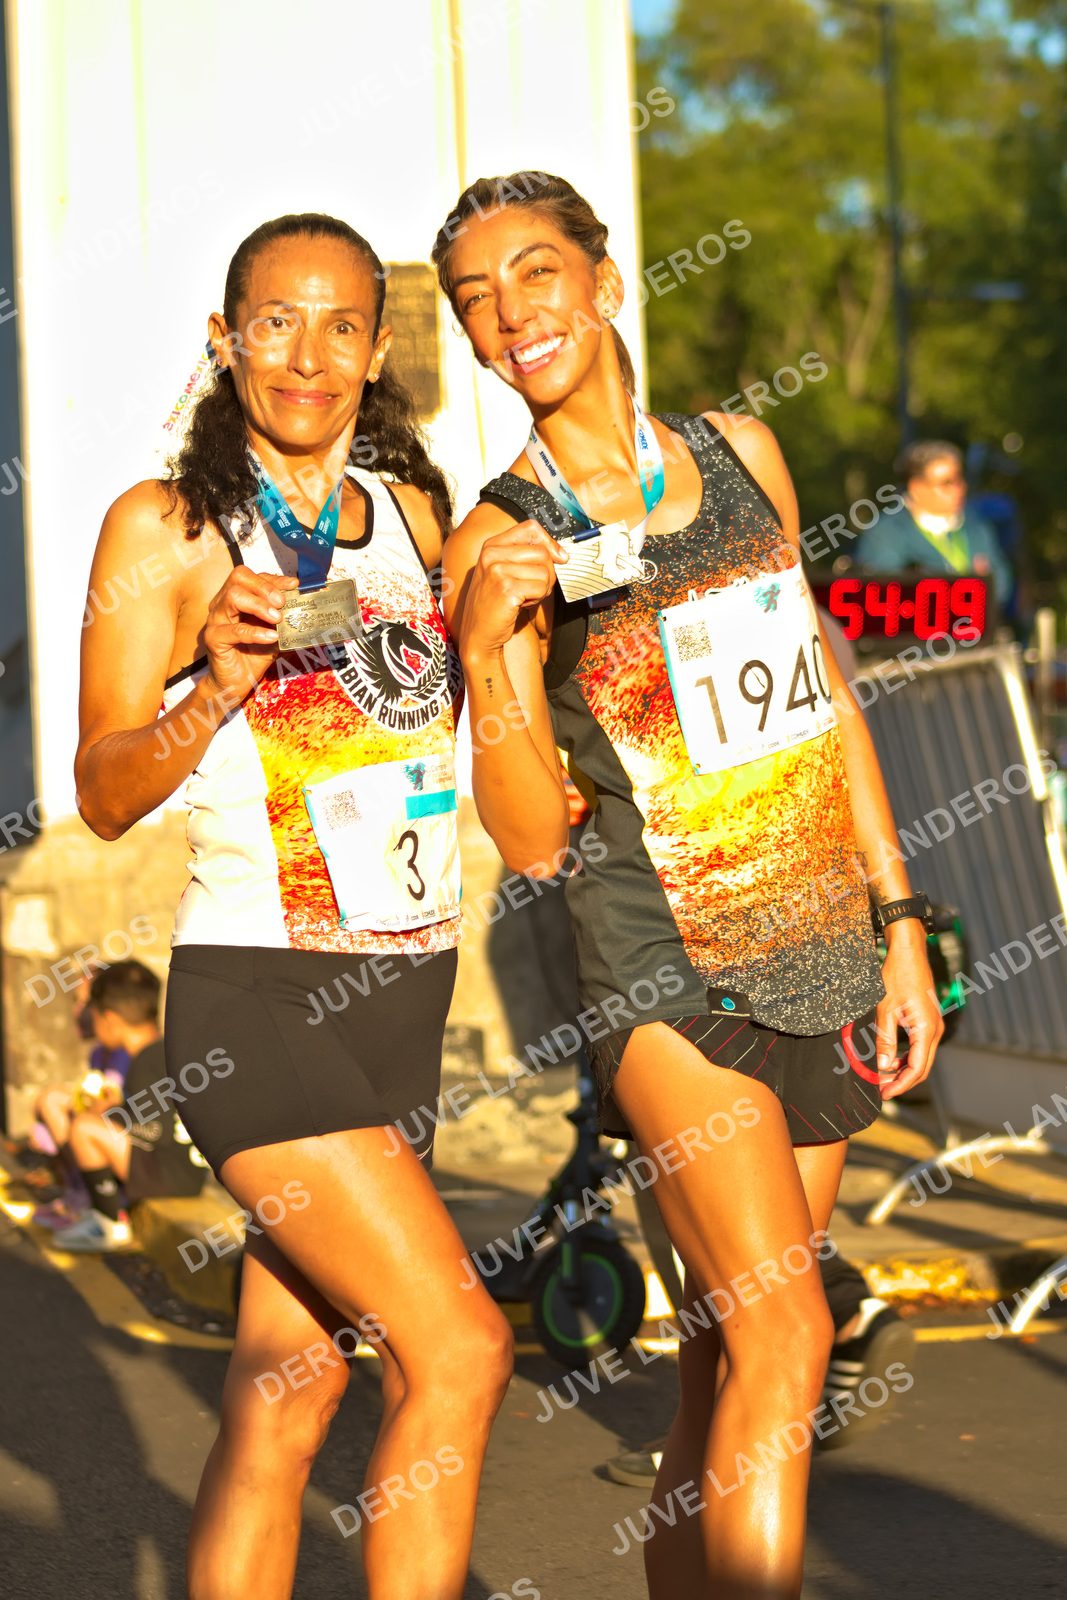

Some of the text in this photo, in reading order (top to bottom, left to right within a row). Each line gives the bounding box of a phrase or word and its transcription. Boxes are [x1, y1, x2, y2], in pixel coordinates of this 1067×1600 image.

[377, 699, 439, 730] RUNNING
[440, 654, 461, 706] TEAM
[397, 829, 426, 901] 3
